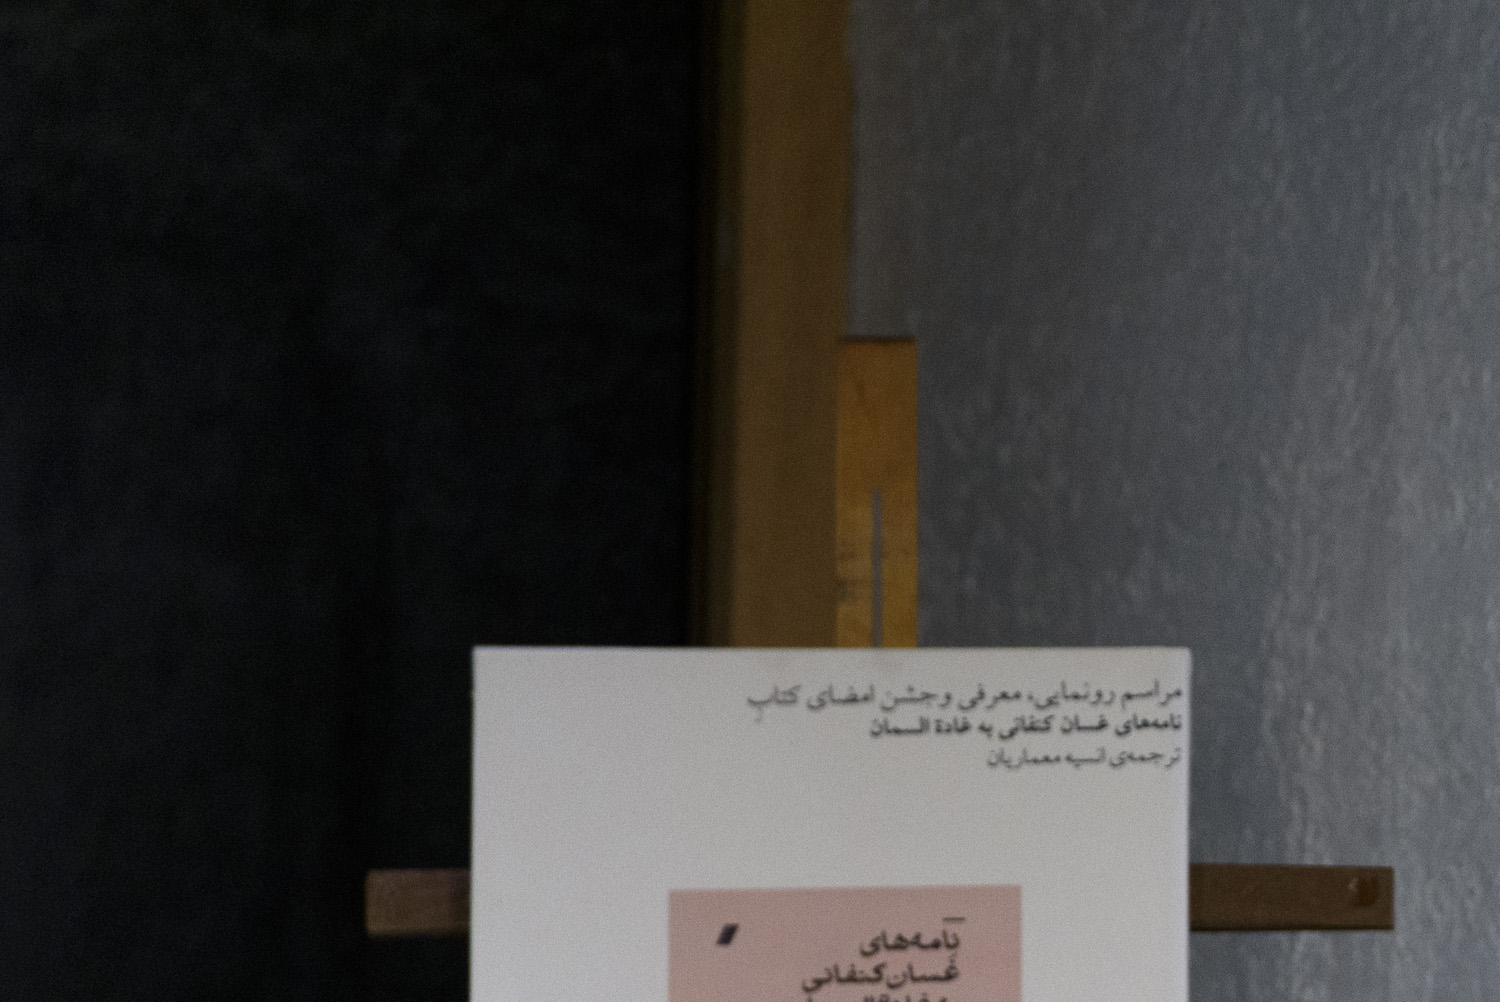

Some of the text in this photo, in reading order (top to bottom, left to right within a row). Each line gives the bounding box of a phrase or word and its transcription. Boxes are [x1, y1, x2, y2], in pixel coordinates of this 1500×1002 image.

[806, 684, 875, 711] امضای
[880, 685, 937, 712] جشن
[958, 683, 1022, 710] معرفی
[1121, 679, 1182, 712] مراسم
[802, 962, 886, 993] کنفانی
